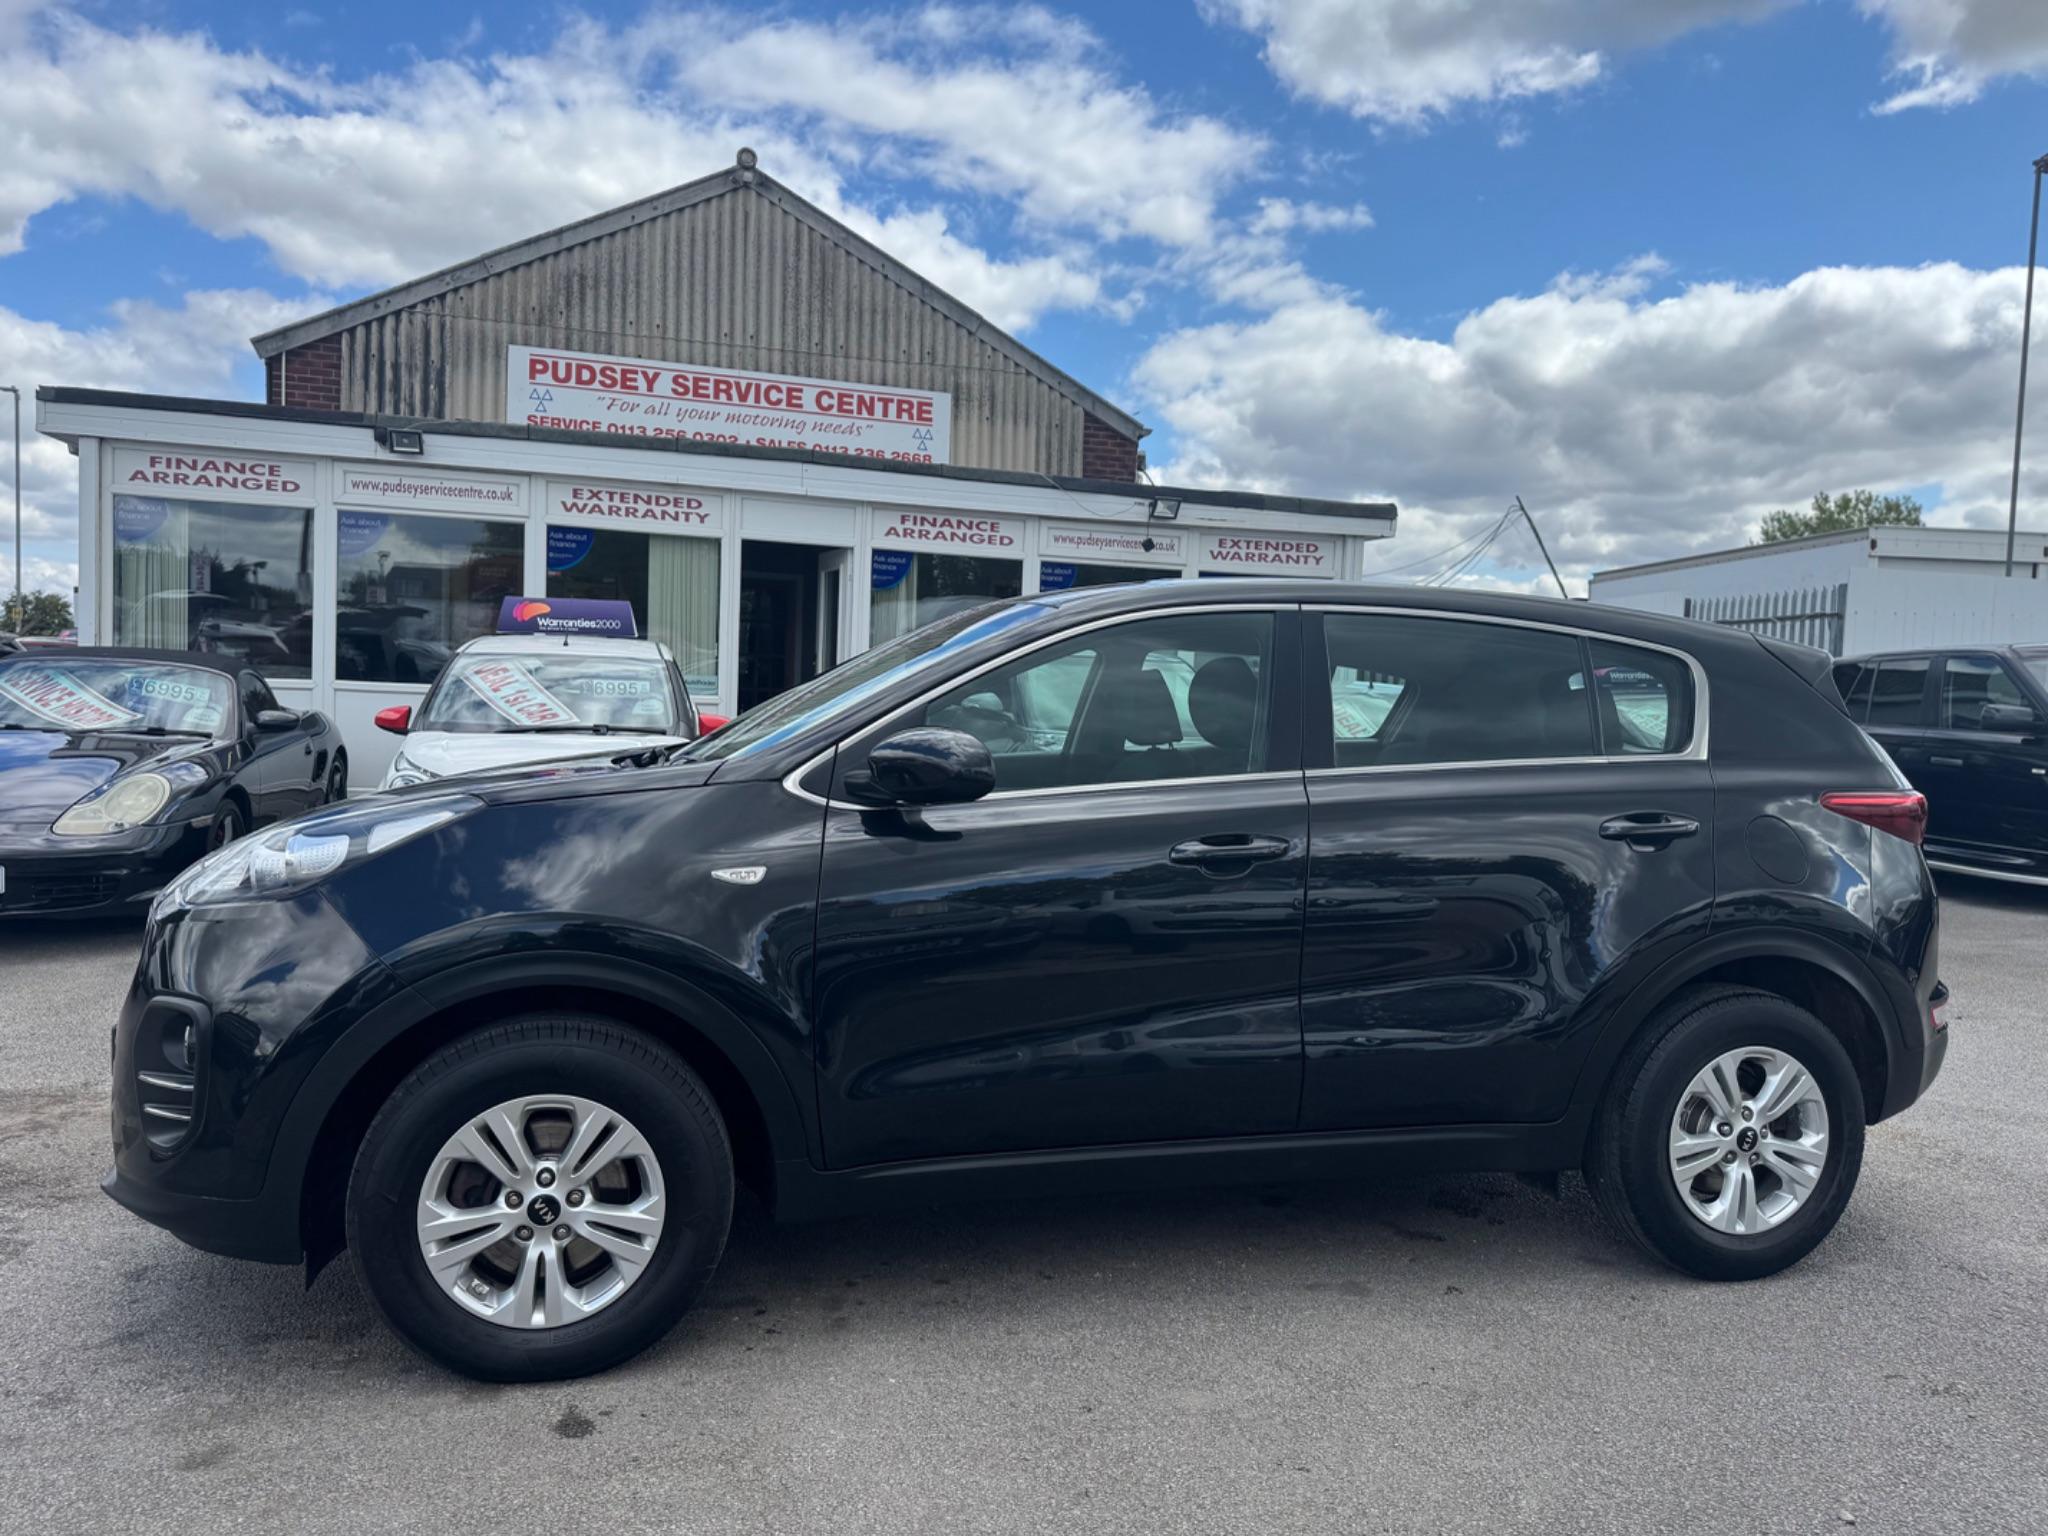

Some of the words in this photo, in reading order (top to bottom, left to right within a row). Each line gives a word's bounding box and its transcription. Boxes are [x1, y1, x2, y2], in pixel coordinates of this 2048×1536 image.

[529, 358, 661, 392] PUDSEY
[671, 373, 804, 409] SERVICE
[815, 389, 933, 423] CENTRE
[644, 402, 671, 416] all
[676, 405, 721, 423] your
[724, 411, 807, 435] motoring
[527, 414, 602, 431] SERVICE
[891, 450, 932, 465] 2668
[149, 455, 282, 477] FINANCE
[128, 470, 301, 493] ARRANGED
[351, 477, 513, 501] www.pudseyservicecentre.co.uk
[571, 487, 703, 510] EXTENDED
[560, 500, 710, 524] WARRANTY
[900, 514, 1000, 533] FINANCE
[565, 532, 587, 542] about
[884, 526, 1014, 547] ARRANGED
[1053, 532, 1176, 552] www.pudseyservicecenco.uk
[1218, 537, 1319, 553] EXTENDED
[1209, 550, 1324, 565] WARRANTY
[537, 616, 621, 630] Warranties2000
[534, 1198, 555, 1223] KIA
